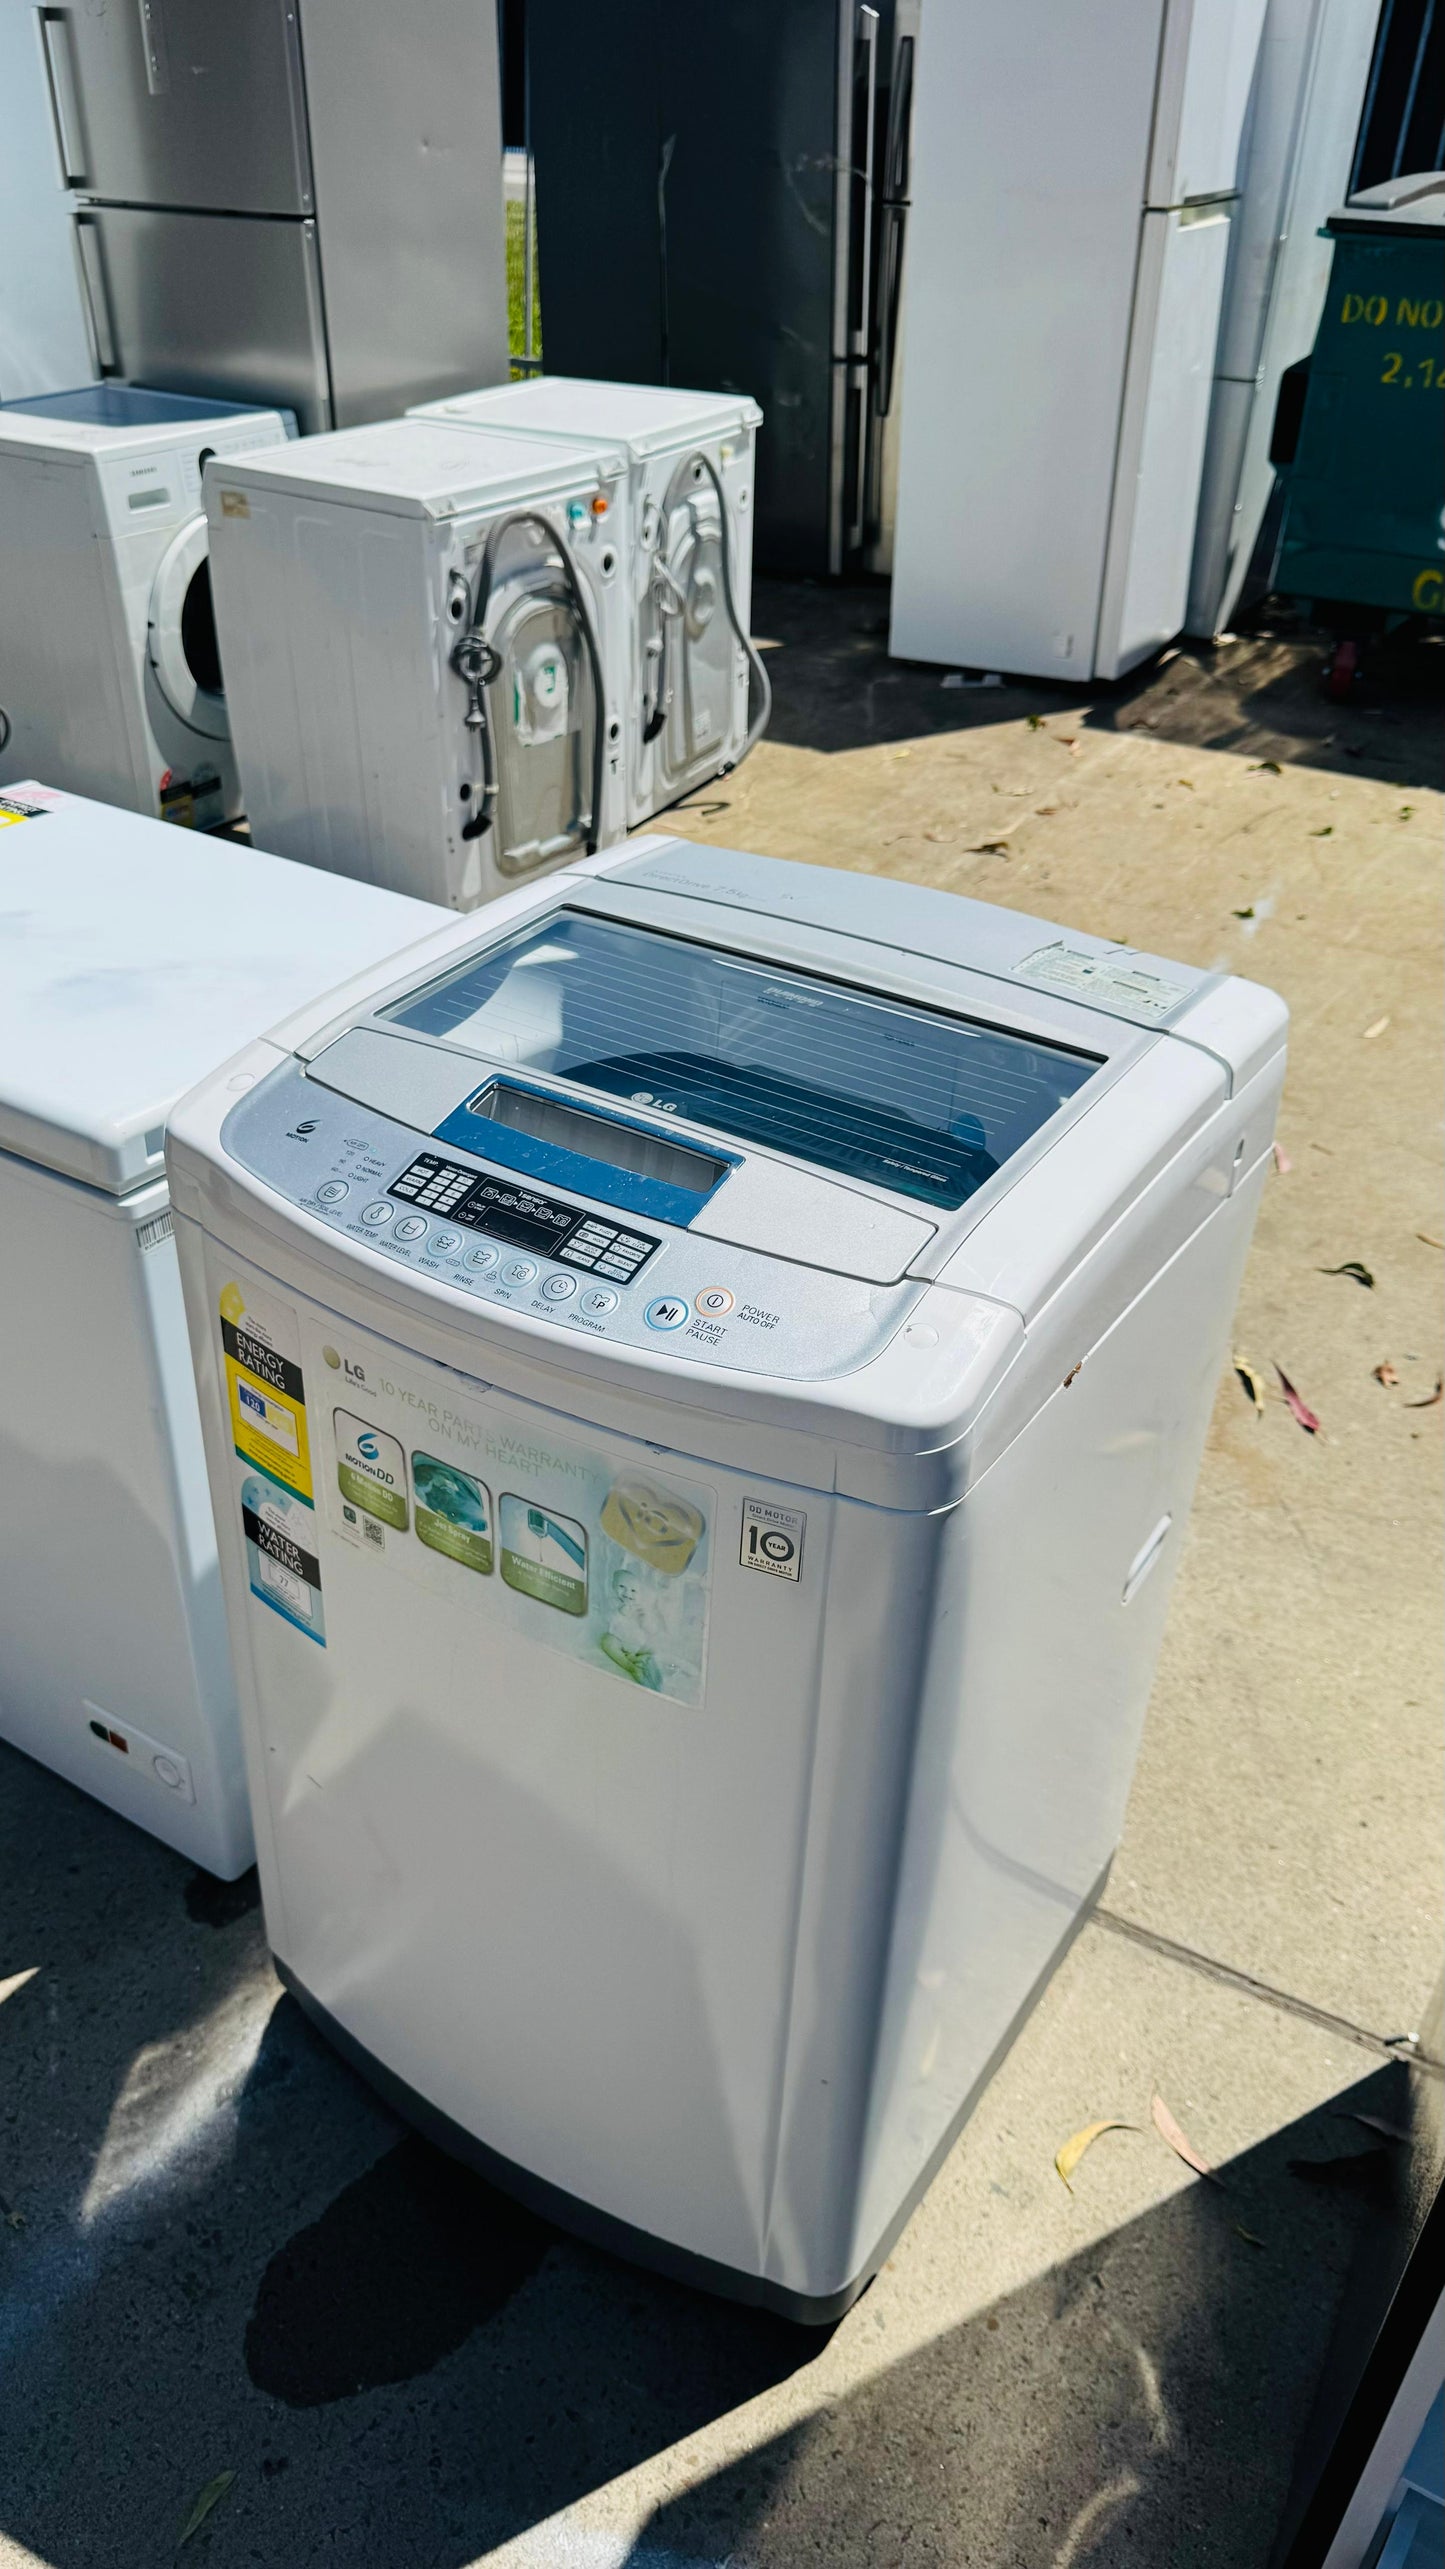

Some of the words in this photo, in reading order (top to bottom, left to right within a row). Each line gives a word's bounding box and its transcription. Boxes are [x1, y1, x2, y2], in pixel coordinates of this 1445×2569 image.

[1341, 294, 1388, 326] DO
[1396, 297, 1444, 328] NO
[652, 1099, 678, 1112] LG
[286, 1132, 309, 1143] MOTION
[362, 1167, 383, 1177] NORMAL
[369, 1159, 385, 1167] HEAVY
[353, 1175, 369, 1183] LIGHT
[405, 1176, 424, 1185] WARM
[399, 1185, 414, 1194] COLD
[346, 1223, 363, 1234] WATER
[364, 1229, 379, 1238] TEMP
[379, 1240, 398, 1250] WATER
[397, 1246, 412, 1257] LEVEL
[622, 1248, 641, 1259] FAVORITE
[418, 1256, 440, 1269] WASH
[453, 1273, 475, 1286] RINSE
[493, 1288, 512, 1299] SPIN
[531, 1300, 556, 1314] DELAY
[742, 1304, 780, 1324] POWER
[568, 1313, 606, 1333] PROGRAM
[693, 1318, 728, 1336] START
[737, 1312, 759, 1325] AUTO
[760, 1321, 776, 1330] OFF
[685, 1328, 721, 1346] PAUSE
[236, 1331, 284, 1373] ENERGY
[238, 1348, 285, 1390] RATING
[344, 1358, 365, 1382] LG
[379, 1378, 395, 1396] 10
[398, 1387, 438, 1418] YEAR
[443, 1410, 495, 1443] PARTS
[500, 1437, 600, 1483] WARRANTY
[428, 1417, 451, 1439] ON
[457, 1431, 480, 1450] MY
[486, 1444, 543, 1477] HEART
[749, 1504, 762, 1514] DD
[764, 1509, 798, 1524] MOTOR
[257, 1520, 301, 1561] WATER
[448, 1525, 471, 1544] Spray
[749, 1525, 794, 1562] 10
[258, 1533, 303, 1575] RATING
[768, 1541, 786, 1552] YEAR
[511, 1555, 538, 1573] Water
[539, 1567, 576, 1590] Efficient
[747, 1555, 793, 1572] WARRANTY
